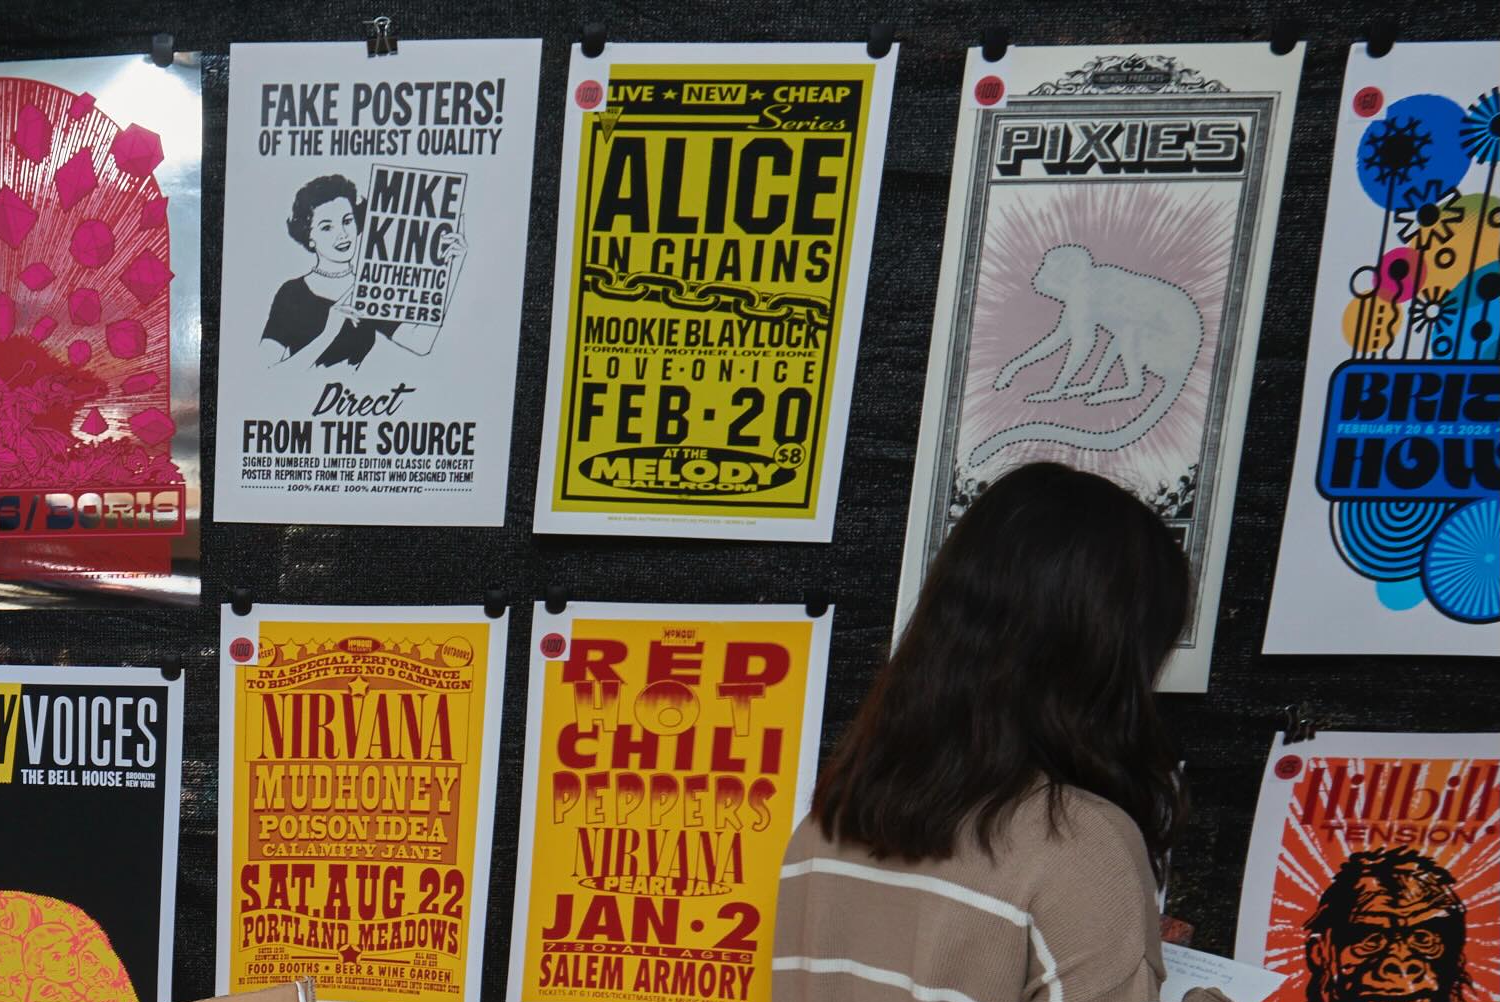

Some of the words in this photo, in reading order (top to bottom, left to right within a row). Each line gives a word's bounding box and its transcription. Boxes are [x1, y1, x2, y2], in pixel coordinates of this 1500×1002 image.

[260, 83, 340, 127] FAKE
[351, 78, 506, 127] POSTERS!
[607, 85, 654, 102] LIVE
[686, 85, 742, 102] NEW
[773, 86, 851, 103] CHEAP
[747, 104, 847, 131] Series
[258, 130, 282, 156] OF
[288, 130, 323, 156] THE
[330, 129, 412, 156] HIGHEST
[417, 128, 503, 156] QUALITY
[996, 119, 1246, 176] PIXIES
[370, 169, 462, 220] MIKE
[592, 137, 845, 235] ALICE
[364, 216, 453, 267] KING
[590, 236, 632, 273] IN
[651, 238, 833, 283] CHAINS
[359, 262, 447, 290] AUTHENTIC
[356, 285, 443, 306] BOOTLEG
[355, 301, 442, 322] POSTERS
[584, 315, 680, 347] MOOKIE
[685, 319, 820, 349] BLAYLOCK
[583, 345, 660, 355] FORMERLY
[664, 347, 728, 357] MOTHER
[732, 349, 771, 358] LOVE
[775, 350, 818, 359] BONE
[311, 382, 417, 417] Direct
[577, 382, 691, 445] FEB
[726, 387, 813, 447] 20
[242, 420, 313, 454] FROM
[320, 421, 368, 455] THE
[376, 421, 477, 456] SOURCE
[1337, 424, 1401, 434] FEBRUARY
[1404, 424, 1421, 435] 20
[1438, 425, 1454, 435] 21
[1457, 425, 1491, 435] 2024
[242, 456, 272, 467] SIGNED
[275, 457, 320, 468] NUMBERED
[323, 458, 357, 469] LIMITED
[359, 458, 392, 469] EDITION
[395, 459, 431, 470] CLASSIC
[435, 459, 474, 471] CONCERT
[663, 448, 679, 459] AT
[682, 448, 708, 459] THE
[777, 447, 802, 464] $8
[242, 469, 272, 480] POSTER
[274, 470, 312, 481] REPRINTS
[315, 470, 338, 481] FROM
[340, 471, 355, 481] THE
[357, 471, 386, 482] ARTIST
[389, 471, 407, 482] WHO
[409, 471, 446, 483] DESIGNED
[449, 471, 474, 483] THEM!
[589, 457, 781, 485] MELODY
[287, 484, 312, 492] 100%
[313, 484, 340, 492] FAKE!
[344, 485, 369, 493] 100%
[370, 485, 423, 493] AUTHENTIC
[612, 479, 758, 492] BALLROOM
[258, 670, 272, 679] IN
[277, 669, 288, 679] A
[289, 655, 349, 676] SPECIAL
[352, 655, 460, 680] PERFORMANCE
[561, 638, 791, 687] RED
[246, 679, 266, 689] TO
[268, 668, 330, 688] BENEFIT
[334, 666, 363, 675] THE
[365, 666, 384, 676] NO
[397, 670, 471, 690] CAMPAIGN
[573, 680, 766, 737] HOT
[21, 695, 158, 768] VOICES
[257, 693, 455, 761] NIRVANA
[556, 722, 784, 774] CHILI
[21, 768, 45, 785] THE
[48, 769, 78, 786] BELL
[81, 770, 123, 788] HOUSE
[125, 772, 156, 781] BROOKLYN
[125, 780, 139, 788] NEW
[140, 780, 156, 789] YORK
[253, 765, 458, 815] MUDHONEY
[552, 770, 777, 833] PEPPERS
[1300, 763, 1500, 826] Hillbill
[259, 815, 370, 841] POISON
[375, 816, 448, 844] IDEA
[1321, 824, 1477, 845] TENSION
[262, 843, 377, 859] CALAMITY
[381, 844, 443, 861] JANE
[570, 827, 747, 885] NIRVANA
[419, 867, 465, 920] 22
[604, 876, 676, 896] PEARL
[682, 880, 732, 897] JAM
[242, 913, 349, 951] PORTLAND
[358, 918, 458, 955] MEADOWS
[542, 894, 680, 945] JAN
[712, 901, 761, 951] 2
[546, 942, 606, 953] 7:30
[621, 945, 668, 957] ALL
[680, 949, 751, 963] AGES
[248, 963, 274, 974] FOOD
[279, 963, 319, 974] BOOTHS
[335, 964, 362, 975] BEER
[367, 965, 373, 975] &
[378, 966, 405, 978] WINE
[410, 968, 451, 982] GARDEN
[538, 953, 624, 991] SALEM
[632, 958, 756, 1001] ARMORY
[538, 989, 566, 997] TICKETS
[568, 990, 579, 998] AT
